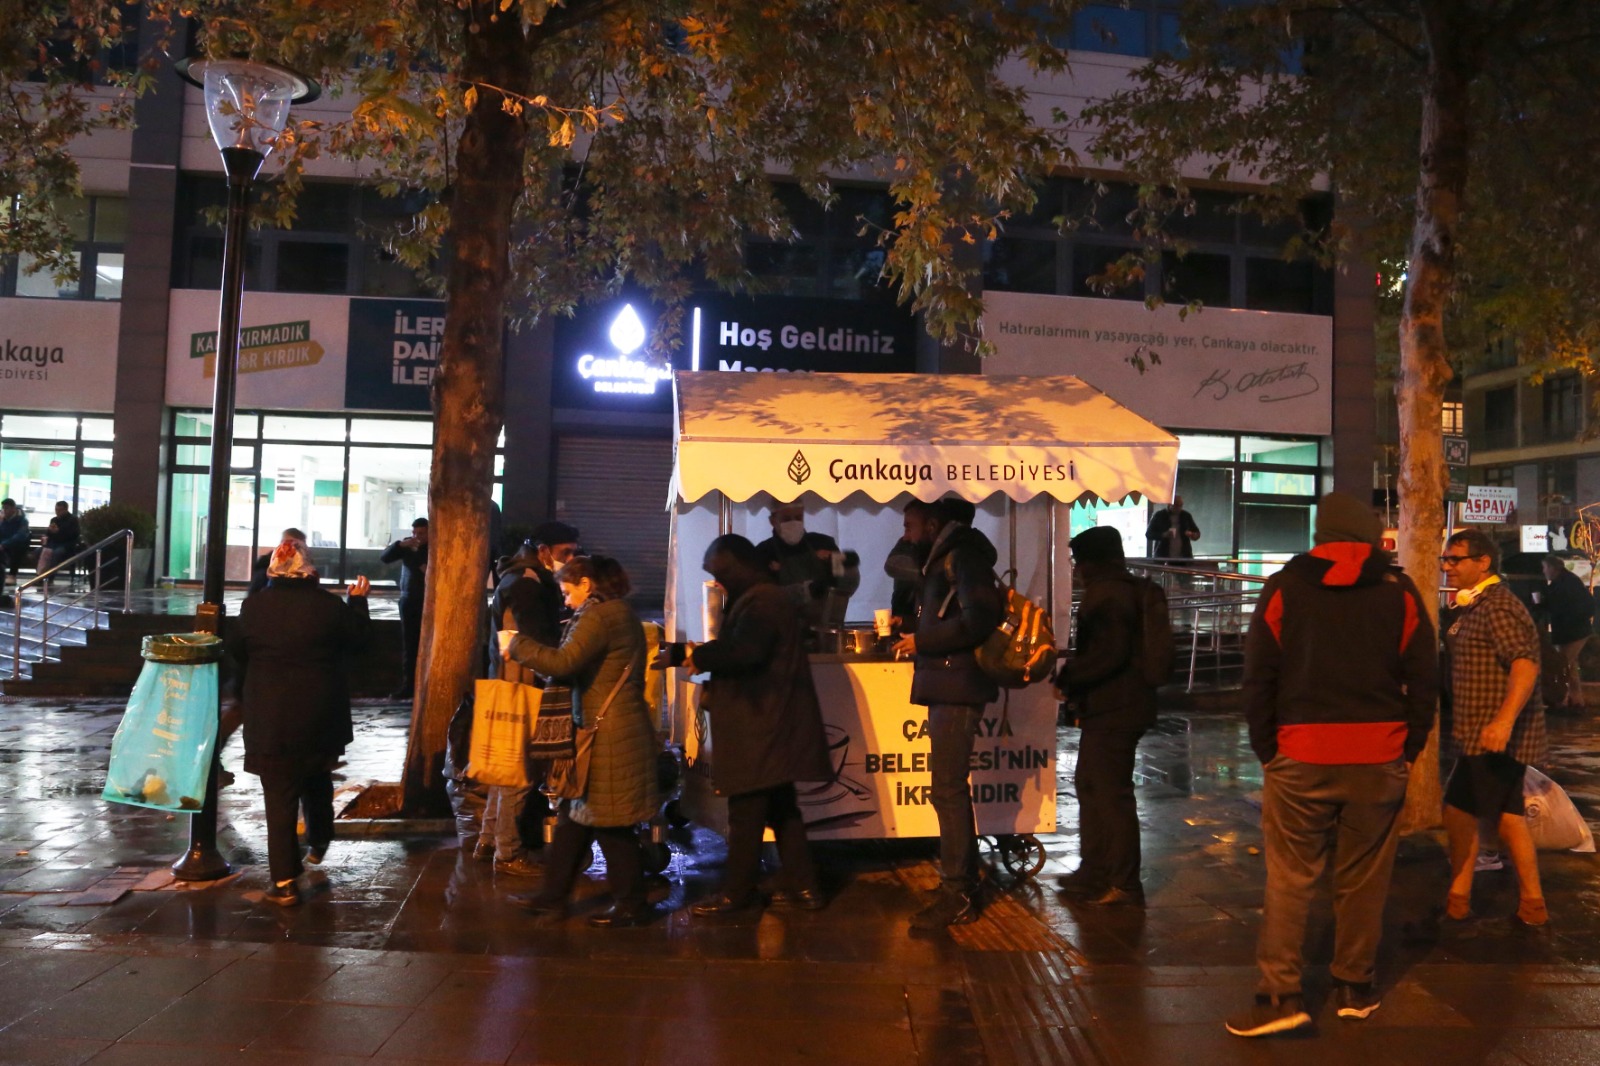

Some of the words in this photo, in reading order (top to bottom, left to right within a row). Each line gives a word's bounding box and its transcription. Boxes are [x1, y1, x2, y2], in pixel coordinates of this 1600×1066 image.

[395, 309, 446, 335] İLER
[238, 324, 305, 347] KIRMADIK
[393, 336, 441, 360] DAİ
[720, 321, 773, 351] Hoş
[780, 324, 894, 354] Geldiniz
[999, 321, 1090, 339] Hatıralarımın
[1094, 329, 1169, 346] yaşayacağı
[1201, 335, 1256, 352] Çankaya
[0, 339, 64, 367] kaya
[263, 346, 310, 366] KIRDIK
[392, 360, 436, 385] İLE
[829, 458, 932, 485] Çankaya
[947, 460, 1074, 481] BELEDİYESİ
[1465, 499, 1515, 514] ASPAVA
